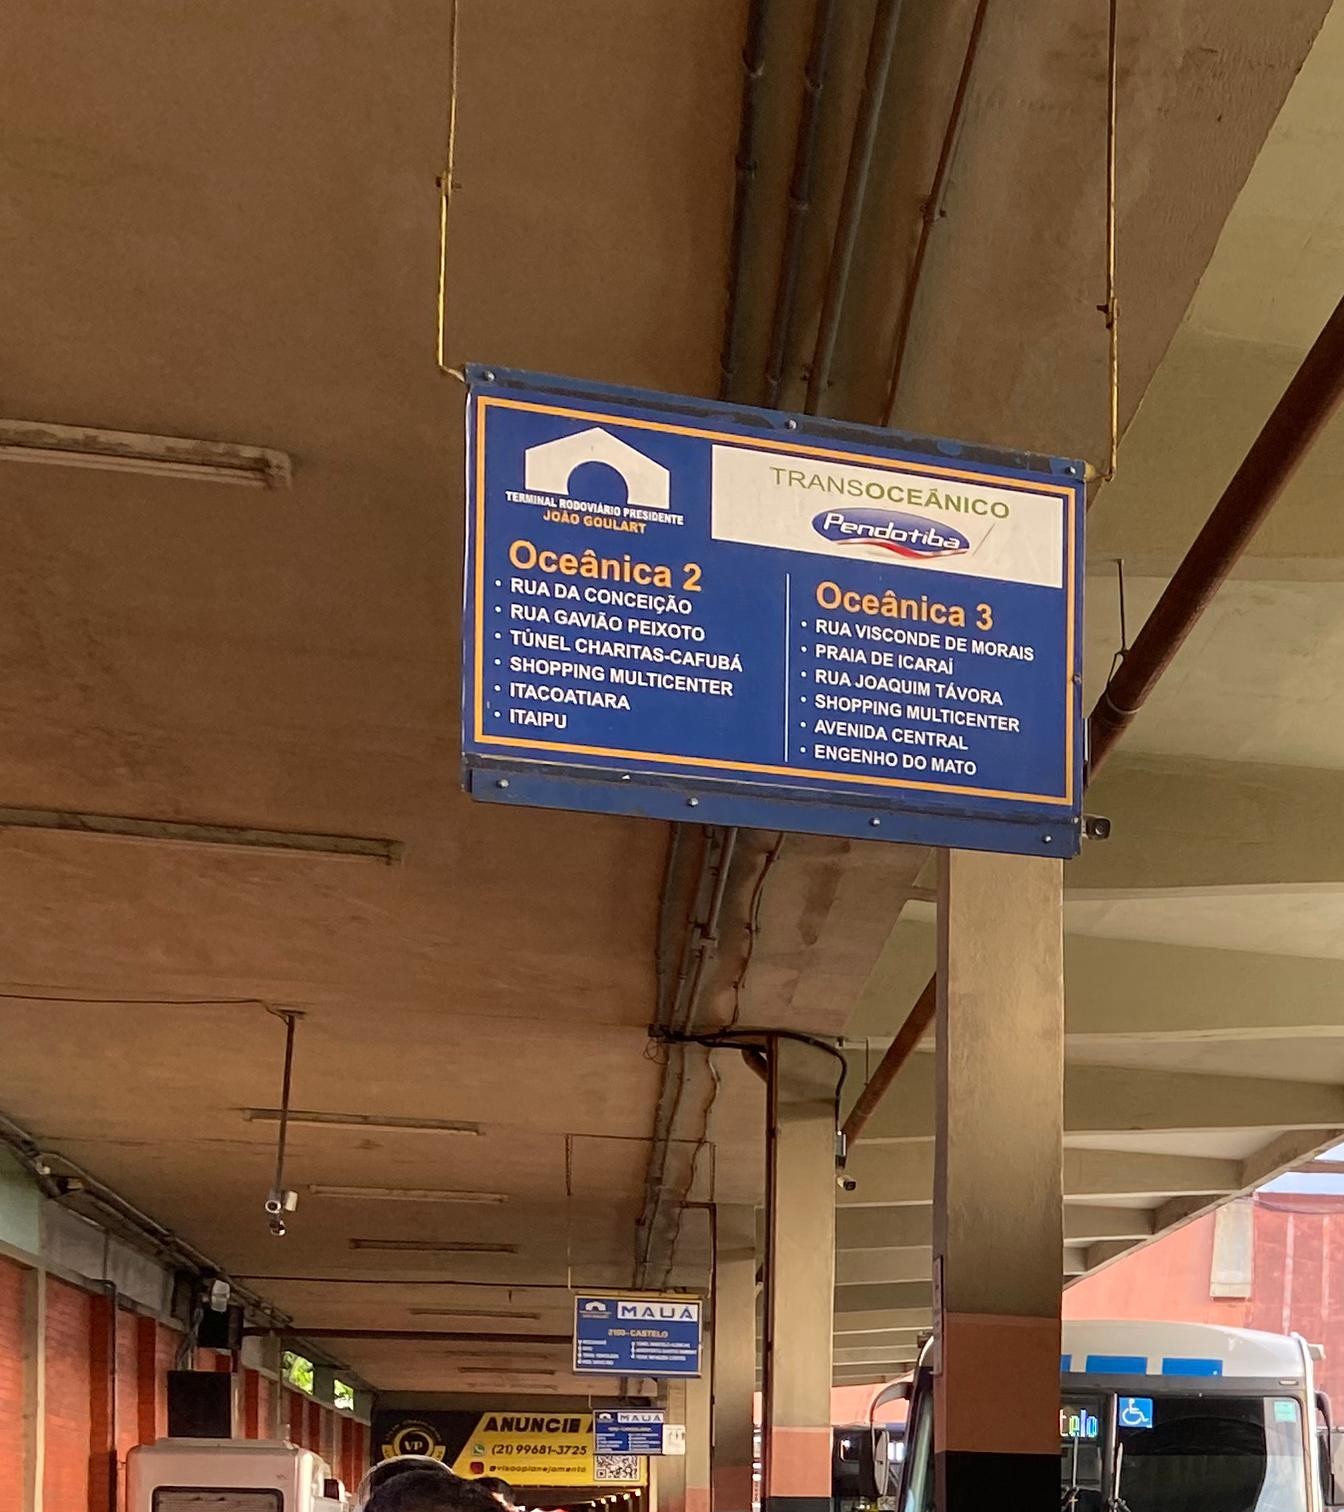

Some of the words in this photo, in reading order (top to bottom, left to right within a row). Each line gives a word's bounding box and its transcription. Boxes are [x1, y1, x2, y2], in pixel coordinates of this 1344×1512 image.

[505, 490, 557, 508] TERMINAL
[559, 497, 621, 517] RODOVIÁRIO
[623, 507, 684, 525] PRESIDENTE
[769, 467, 1010, 519] TRANSOCEÂNICO
[543, 510, 579, 525] JOÃO
[583, 516, 647, 534] GOULART
[823, 512, 960, 550] Pendotiba
[509, 539, 672, 589] Oceânica
[682, 563, 703, 592] 2
[510, 577, 550, 597] RUA
[554, 584, 580, 601] DA
[584, 588, 692, 615] CONCEIÇÃO
[816, 580, 966, 628] Oceânica
[976, 602, 994, 631] 3
[510, 603, 550, 623] RUA
[554, 609, 623, 632] GAVIÃO
[628, 618, 705, 642] PEIXOTO
[815, 619, 851, 638] RUA
[855, 624, 940, 648] VISCONDE
[944, 636, 967, 652] DE
[971, 639, 1035, 661] MORAIS
[510, 628, 570, 652] TÚNEL
[575, 638, 743, 672] CHARITAS-CAFUBÁ
[815, 644, 867, 664] PRAIA
[871, 651, 894, 668] DE
[898, 656, 954, 675] ICARAÍ
[510, 656, 605, 681] SHOPPING
[610, 668, 733, 696] MULTICENTER
[815, 669, 851, 688] RUA
[855, 674, 930, 697] JOAQUIM
[935, 683, 1003, 706] TÁVORA
[510, 682, 630, 710] ITACOATIARA
[815, 694, 902, 718] SHOPPING
[906, 705, 1020, 732] MULTICENTER
[510, 708, 567, 729] ITAIPU
[814, 719, 888, 741] AVENIDA
[891, 729, 968, 750] CENTRAL
[814, 744, 898, 768] ENGENHO
[902, 755, 927, 771] DO
[931, 757, 977, 776] MATO
[621, 1306, 693, 1319] MAUÁ
[483, 1417, 581, 1433] ANUNCIE
[491, 1444, 513, 1456] (21)
[516, 1445, 588, 1456] 99681-3725
